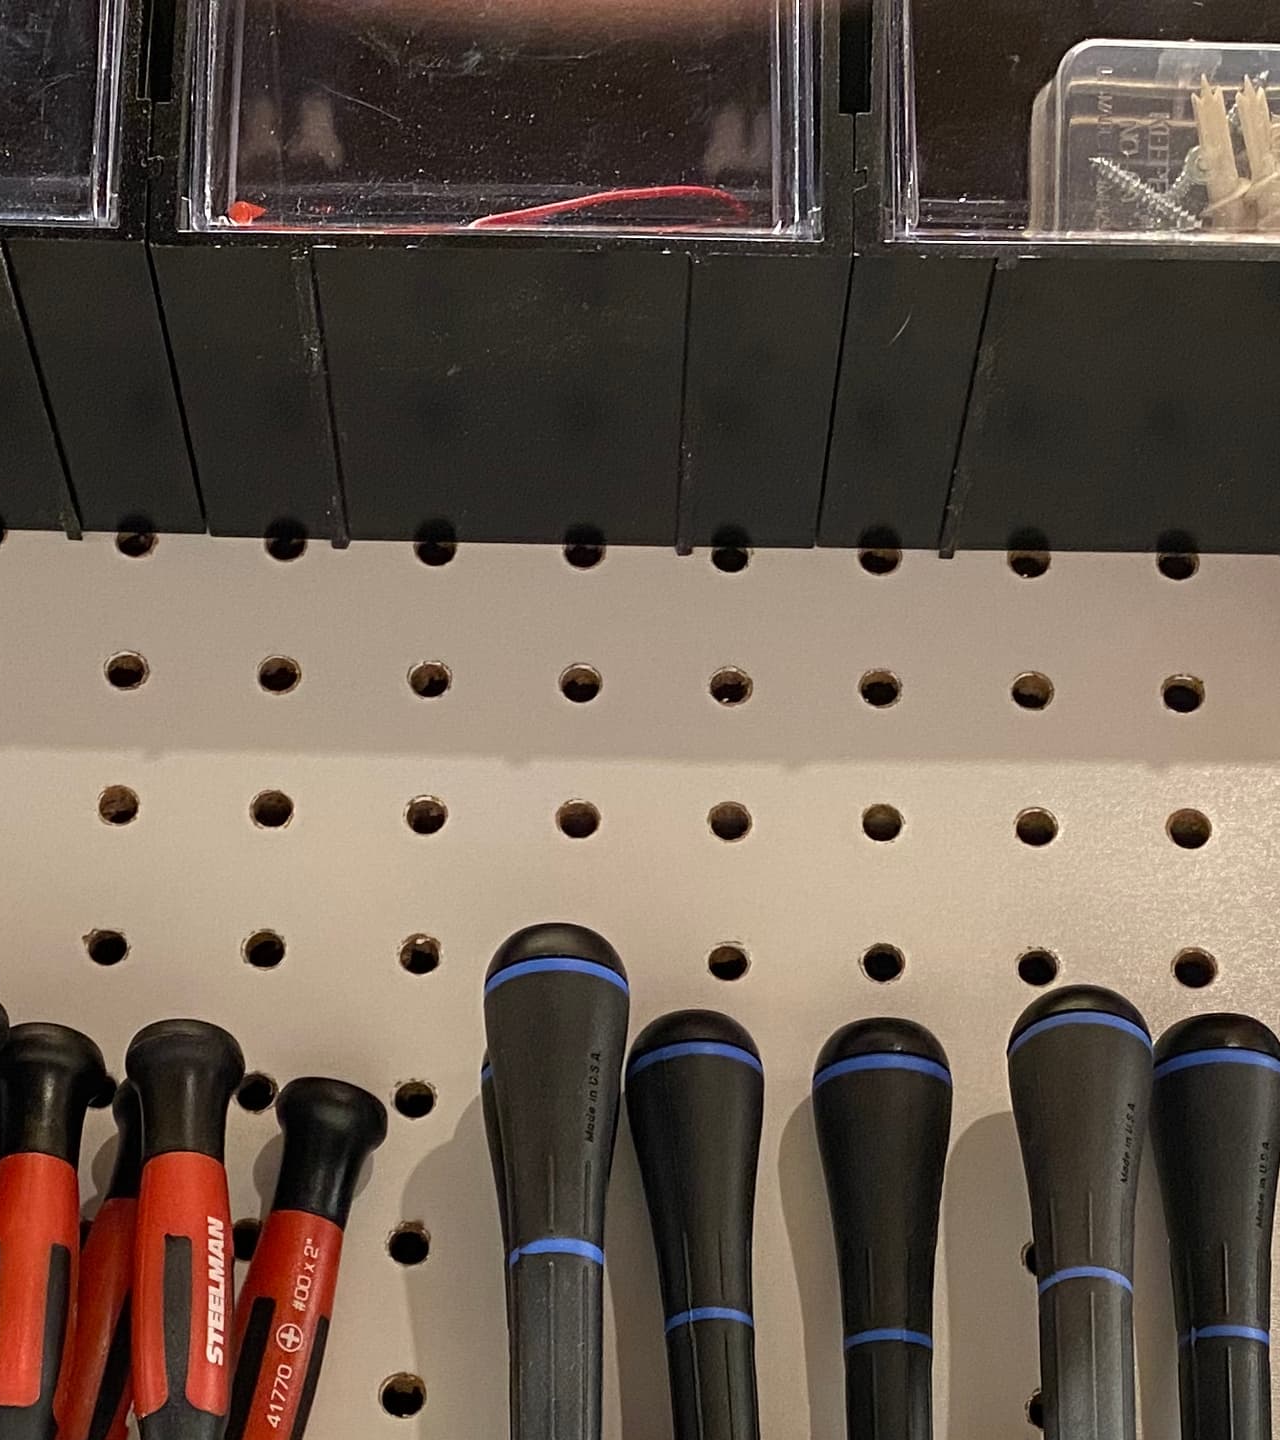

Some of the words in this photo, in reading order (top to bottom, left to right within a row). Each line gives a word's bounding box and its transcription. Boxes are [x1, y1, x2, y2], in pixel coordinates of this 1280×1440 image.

[204, 1216, 224, 1366] STEELMAN
[265, 1363, 293, 1428] 41770
[291, 1273, 313, 1312] #00
[303, 1261, 316, 1274] x
